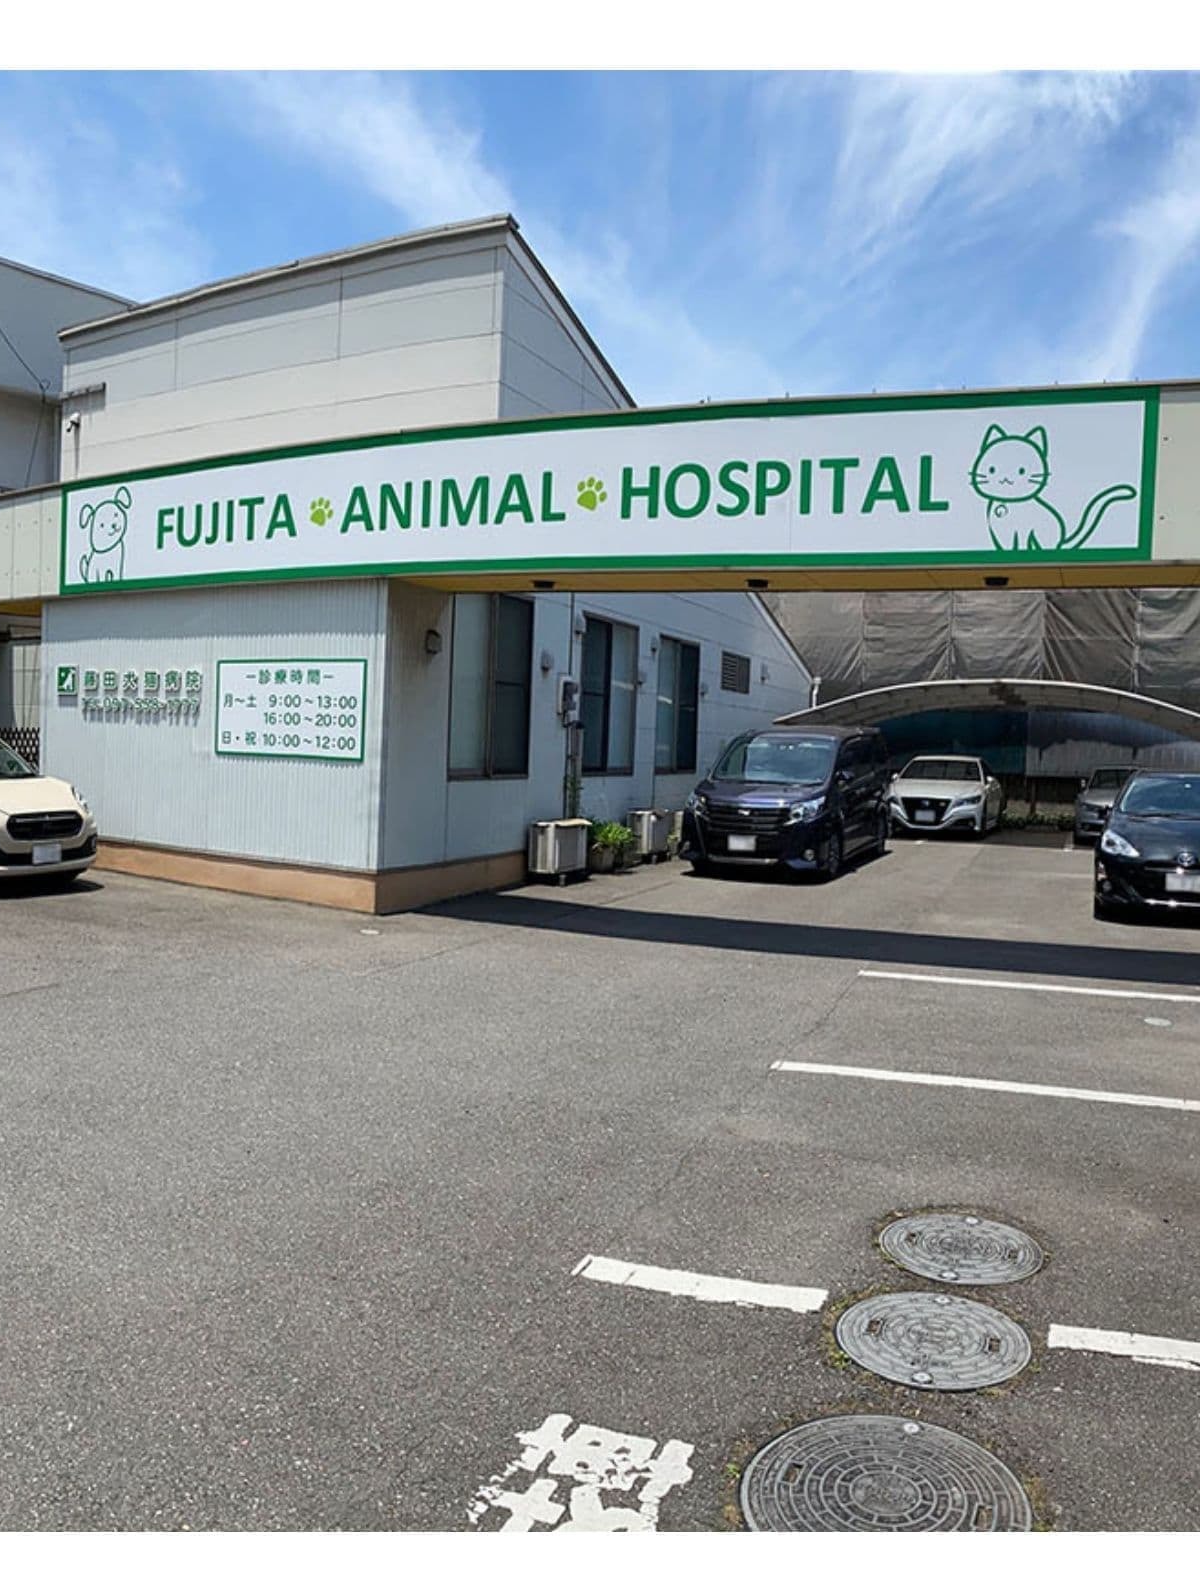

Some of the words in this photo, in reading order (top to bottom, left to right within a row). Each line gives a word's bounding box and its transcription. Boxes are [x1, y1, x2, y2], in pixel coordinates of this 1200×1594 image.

[156, 493, 298, 549] FUJITA
[340, 471, 566, 534] ANIMAL
[620, 455, 949, 520] HOSPITAL
